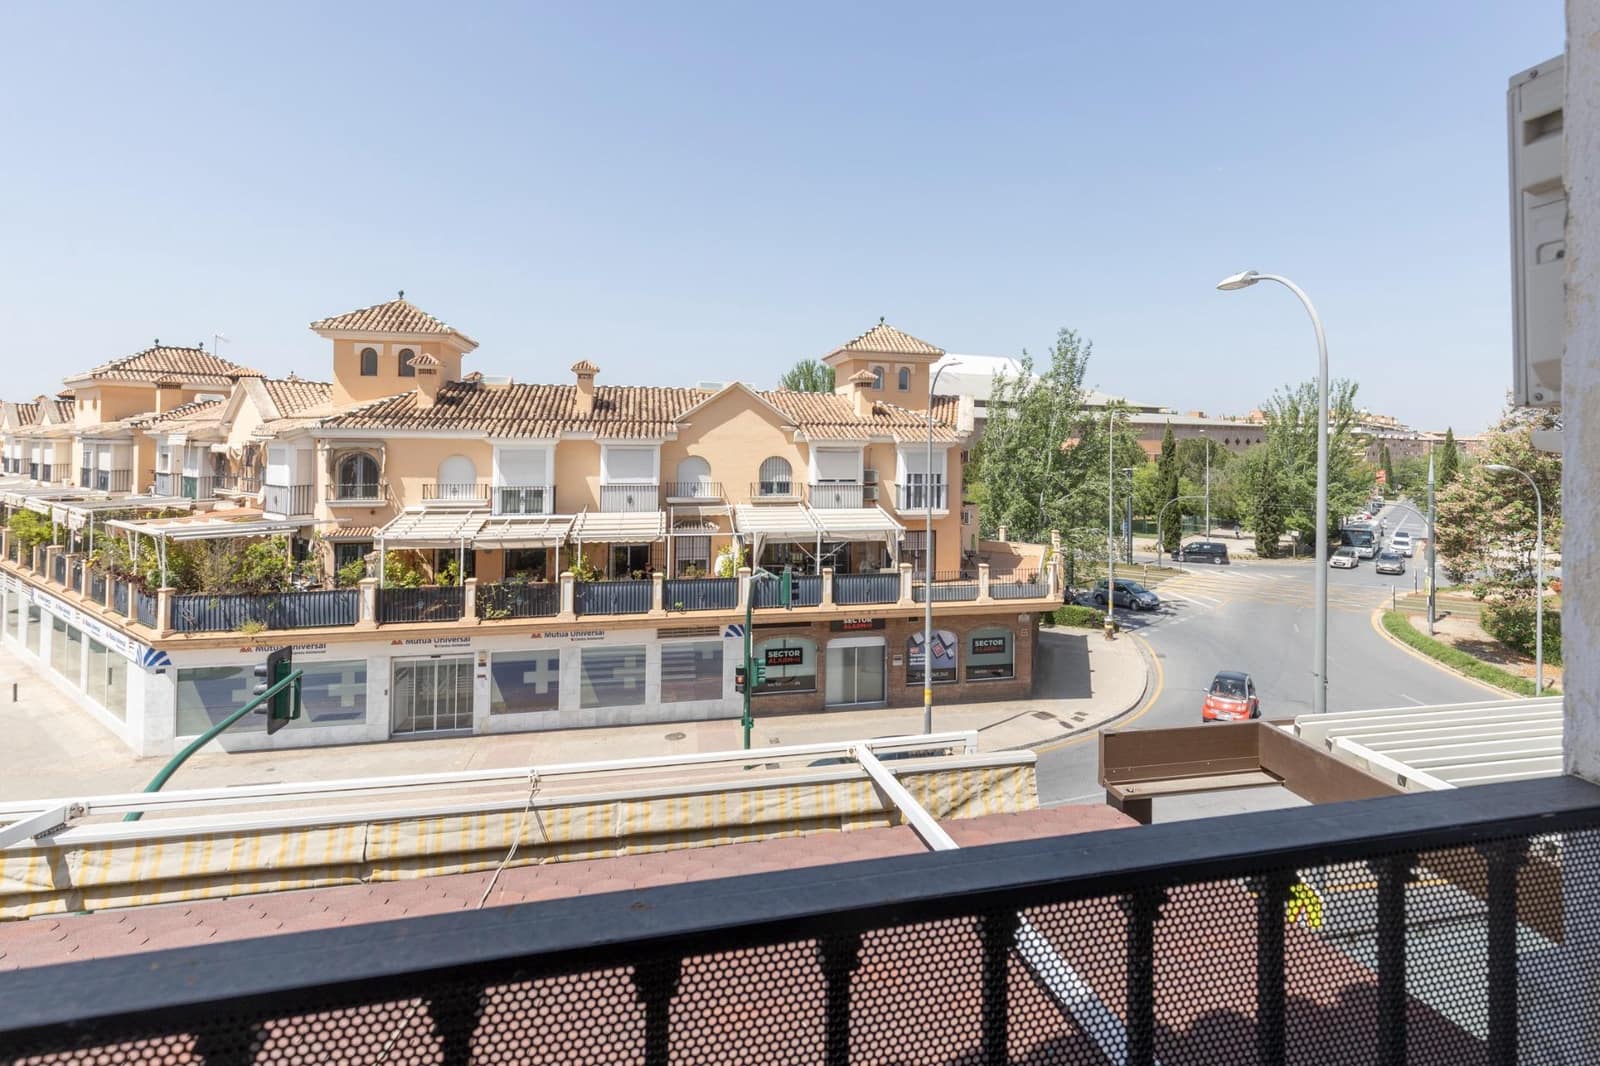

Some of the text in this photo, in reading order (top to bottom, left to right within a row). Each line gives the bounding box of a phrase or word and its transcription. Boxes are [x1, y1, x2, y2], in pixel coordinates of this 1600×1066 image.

[544, 631, 569, 639] Mutua
[570, 629, 605, 637] Universal
[433, 636, 471, 644] Universal
[975, 639, 1004, 647] SECTOR
[292, 642, 327, 651] niversal
[767, 650, 801, 658] SECTOR
